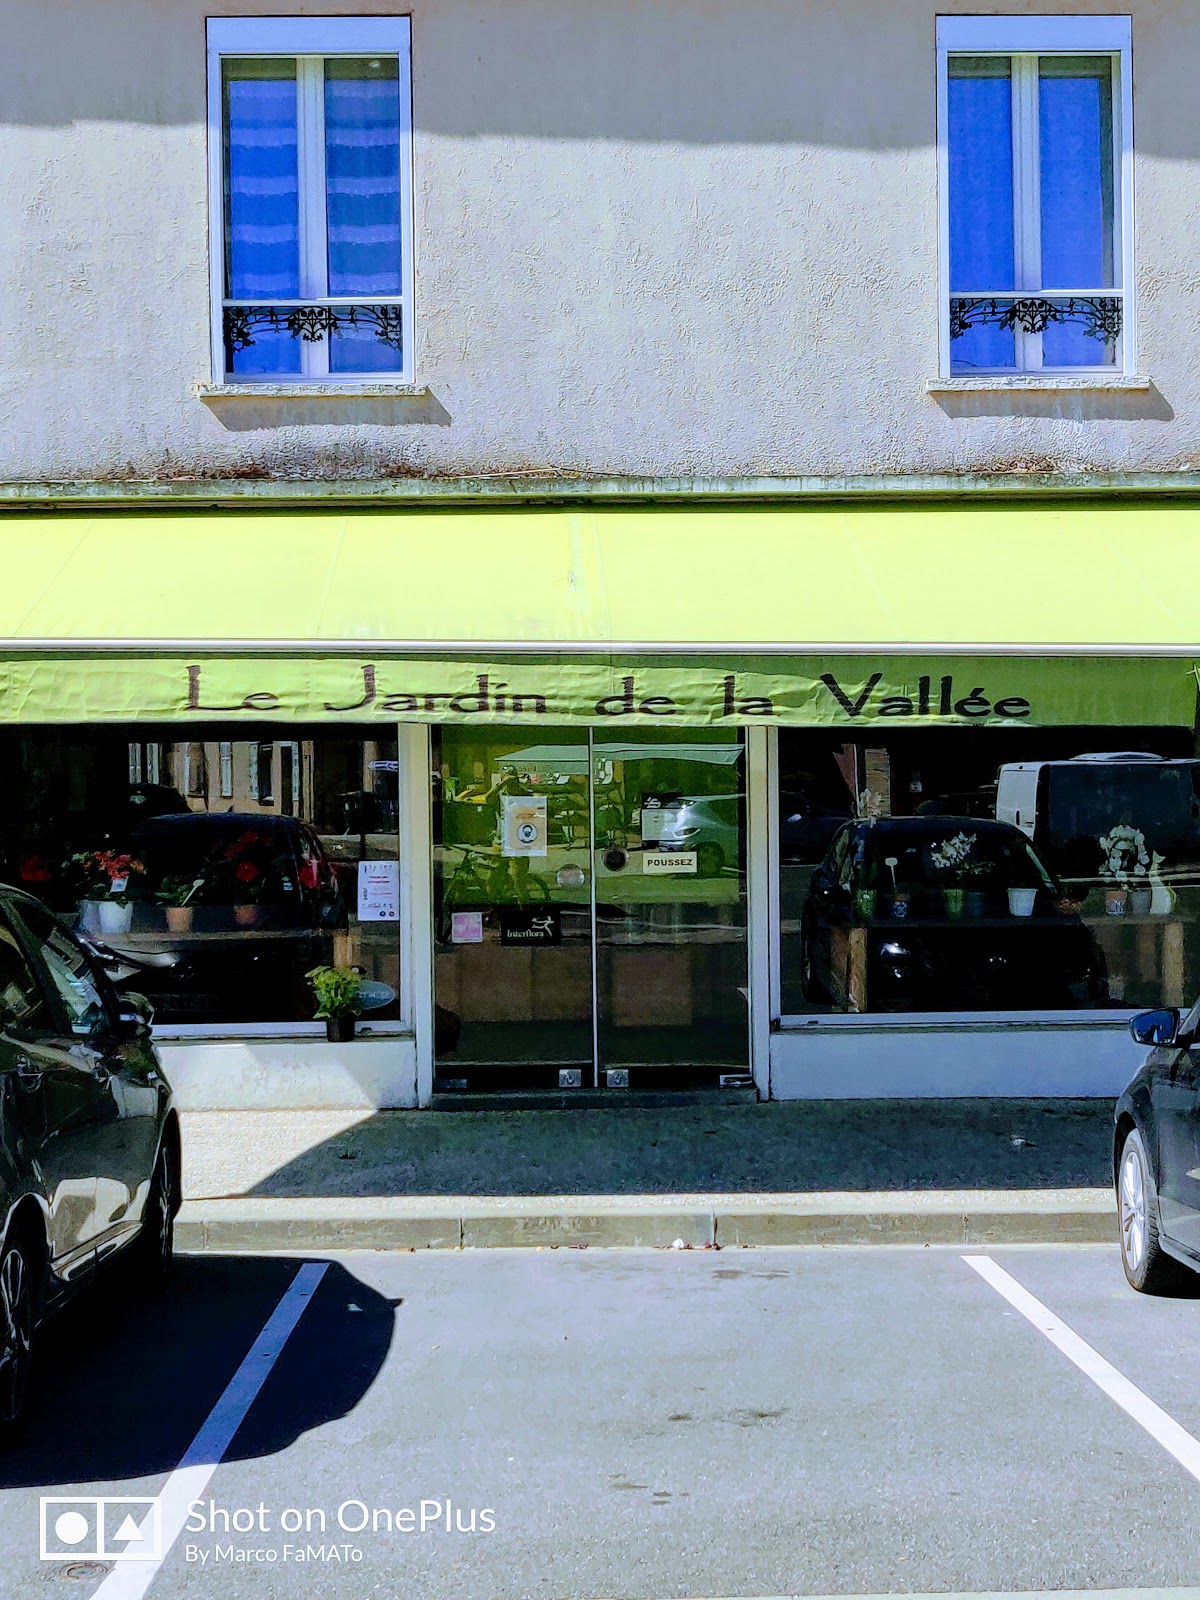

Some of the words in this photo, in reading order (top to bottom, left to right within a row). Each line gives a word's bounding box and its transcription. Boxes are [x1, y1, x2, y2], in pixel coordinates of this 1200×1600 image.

[186, 664, 279, 712] Le
[323, 664, 548, 713] Jardin
[594, 676, 677, 716] de
[723, 675, 776, 716] la
[818, 672, 1031, 717] Vallée
[647, 859, 694, 867] POUSSEZ
[507, 929, 544, 938] Interflora
